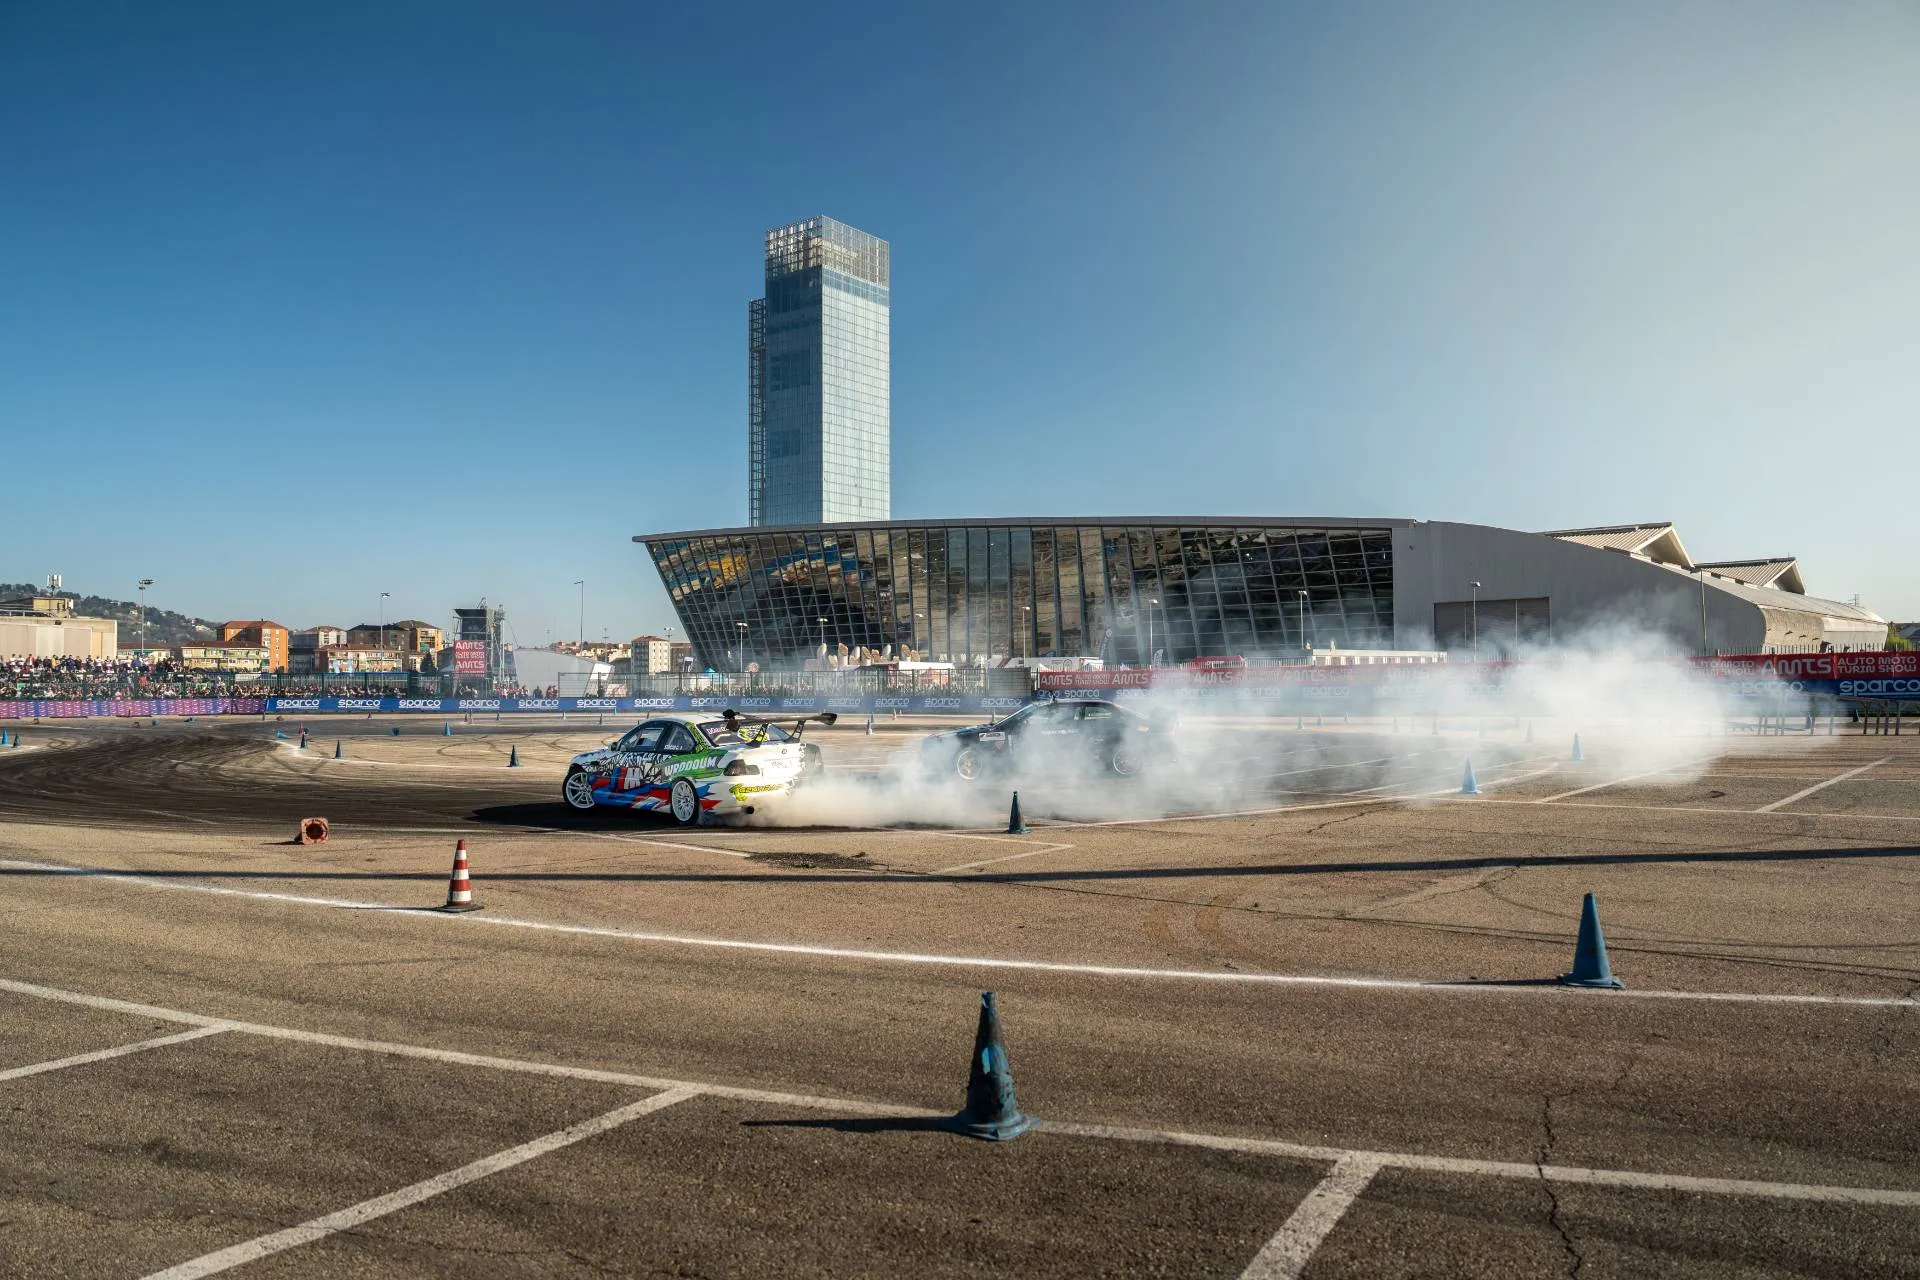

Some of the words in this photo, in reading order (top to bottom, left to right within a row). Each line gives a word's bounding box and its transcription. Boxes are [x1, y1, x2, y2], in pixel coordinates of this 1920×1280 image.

[455, 641, 485, 650] AMTS
[455, 660, 485, 669] AMTS
[1761, 658, 1831, 675] AMTS
[1838, 656, 1875, 666] AUTO
[1878, 656, 1917, 665] MOTO
[1838, 665, 1875, 673] TURIN
[1878, 664, 1917, 672] SHOW
[1041, 674, 1073, 686] AMTS
[1111, 673, 1149, 685] AMTS
[1839, 680, 1920, 696] sparco
[1064, 689, 1100, 699] sparco
[276, 699, 319, 709] sparco
[338, 699, 381, 709] sparco
[399, 699, 441, 709] sparco
[459, 699, 499, 709] sparco
[518, 699, 559, 709] sparco
[577, 699, 617, 708] sparco
[634, 698, 674, 708] sparco
[692, 697, 728, 707] sparco
[875, 698, 910, 708] sparco
[924, 698, 961, 708] sparco
[980, 698, 1021, 708] sparco
